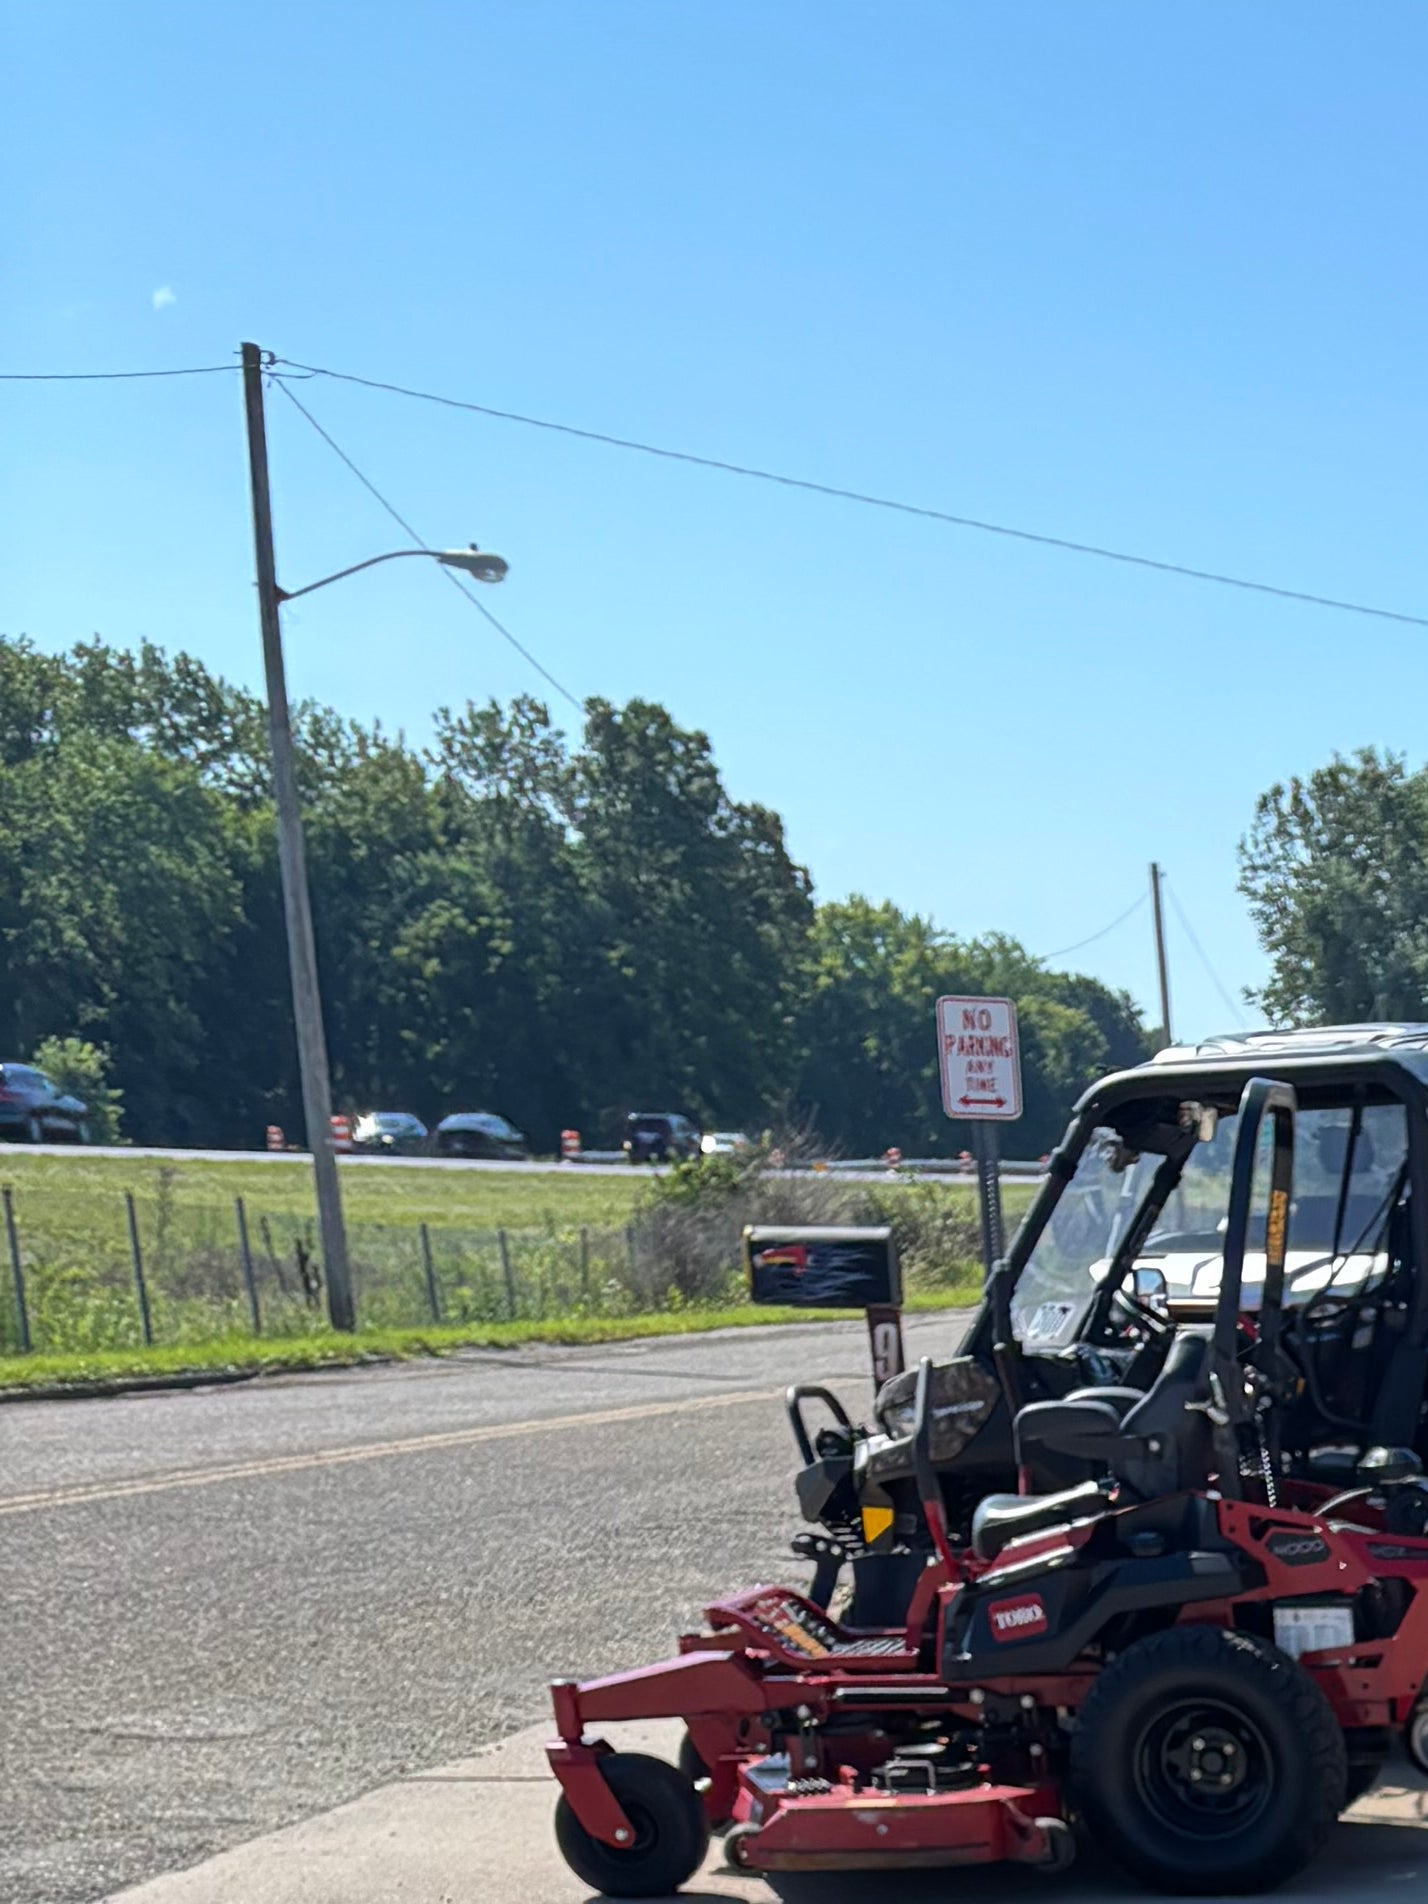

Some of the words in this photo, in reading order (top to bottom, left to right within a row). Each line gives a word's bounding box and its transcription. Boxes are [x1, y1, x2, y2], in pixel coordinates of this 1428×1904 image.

[961, 1008, 992, 1031] NO
[945, 1034, 1014, 1057] PARKING
[965, 1060, 994, 1075] ANY
[873, 1322, 899, 1381] 9
[994, 1604, 1043, 1630] TORO
